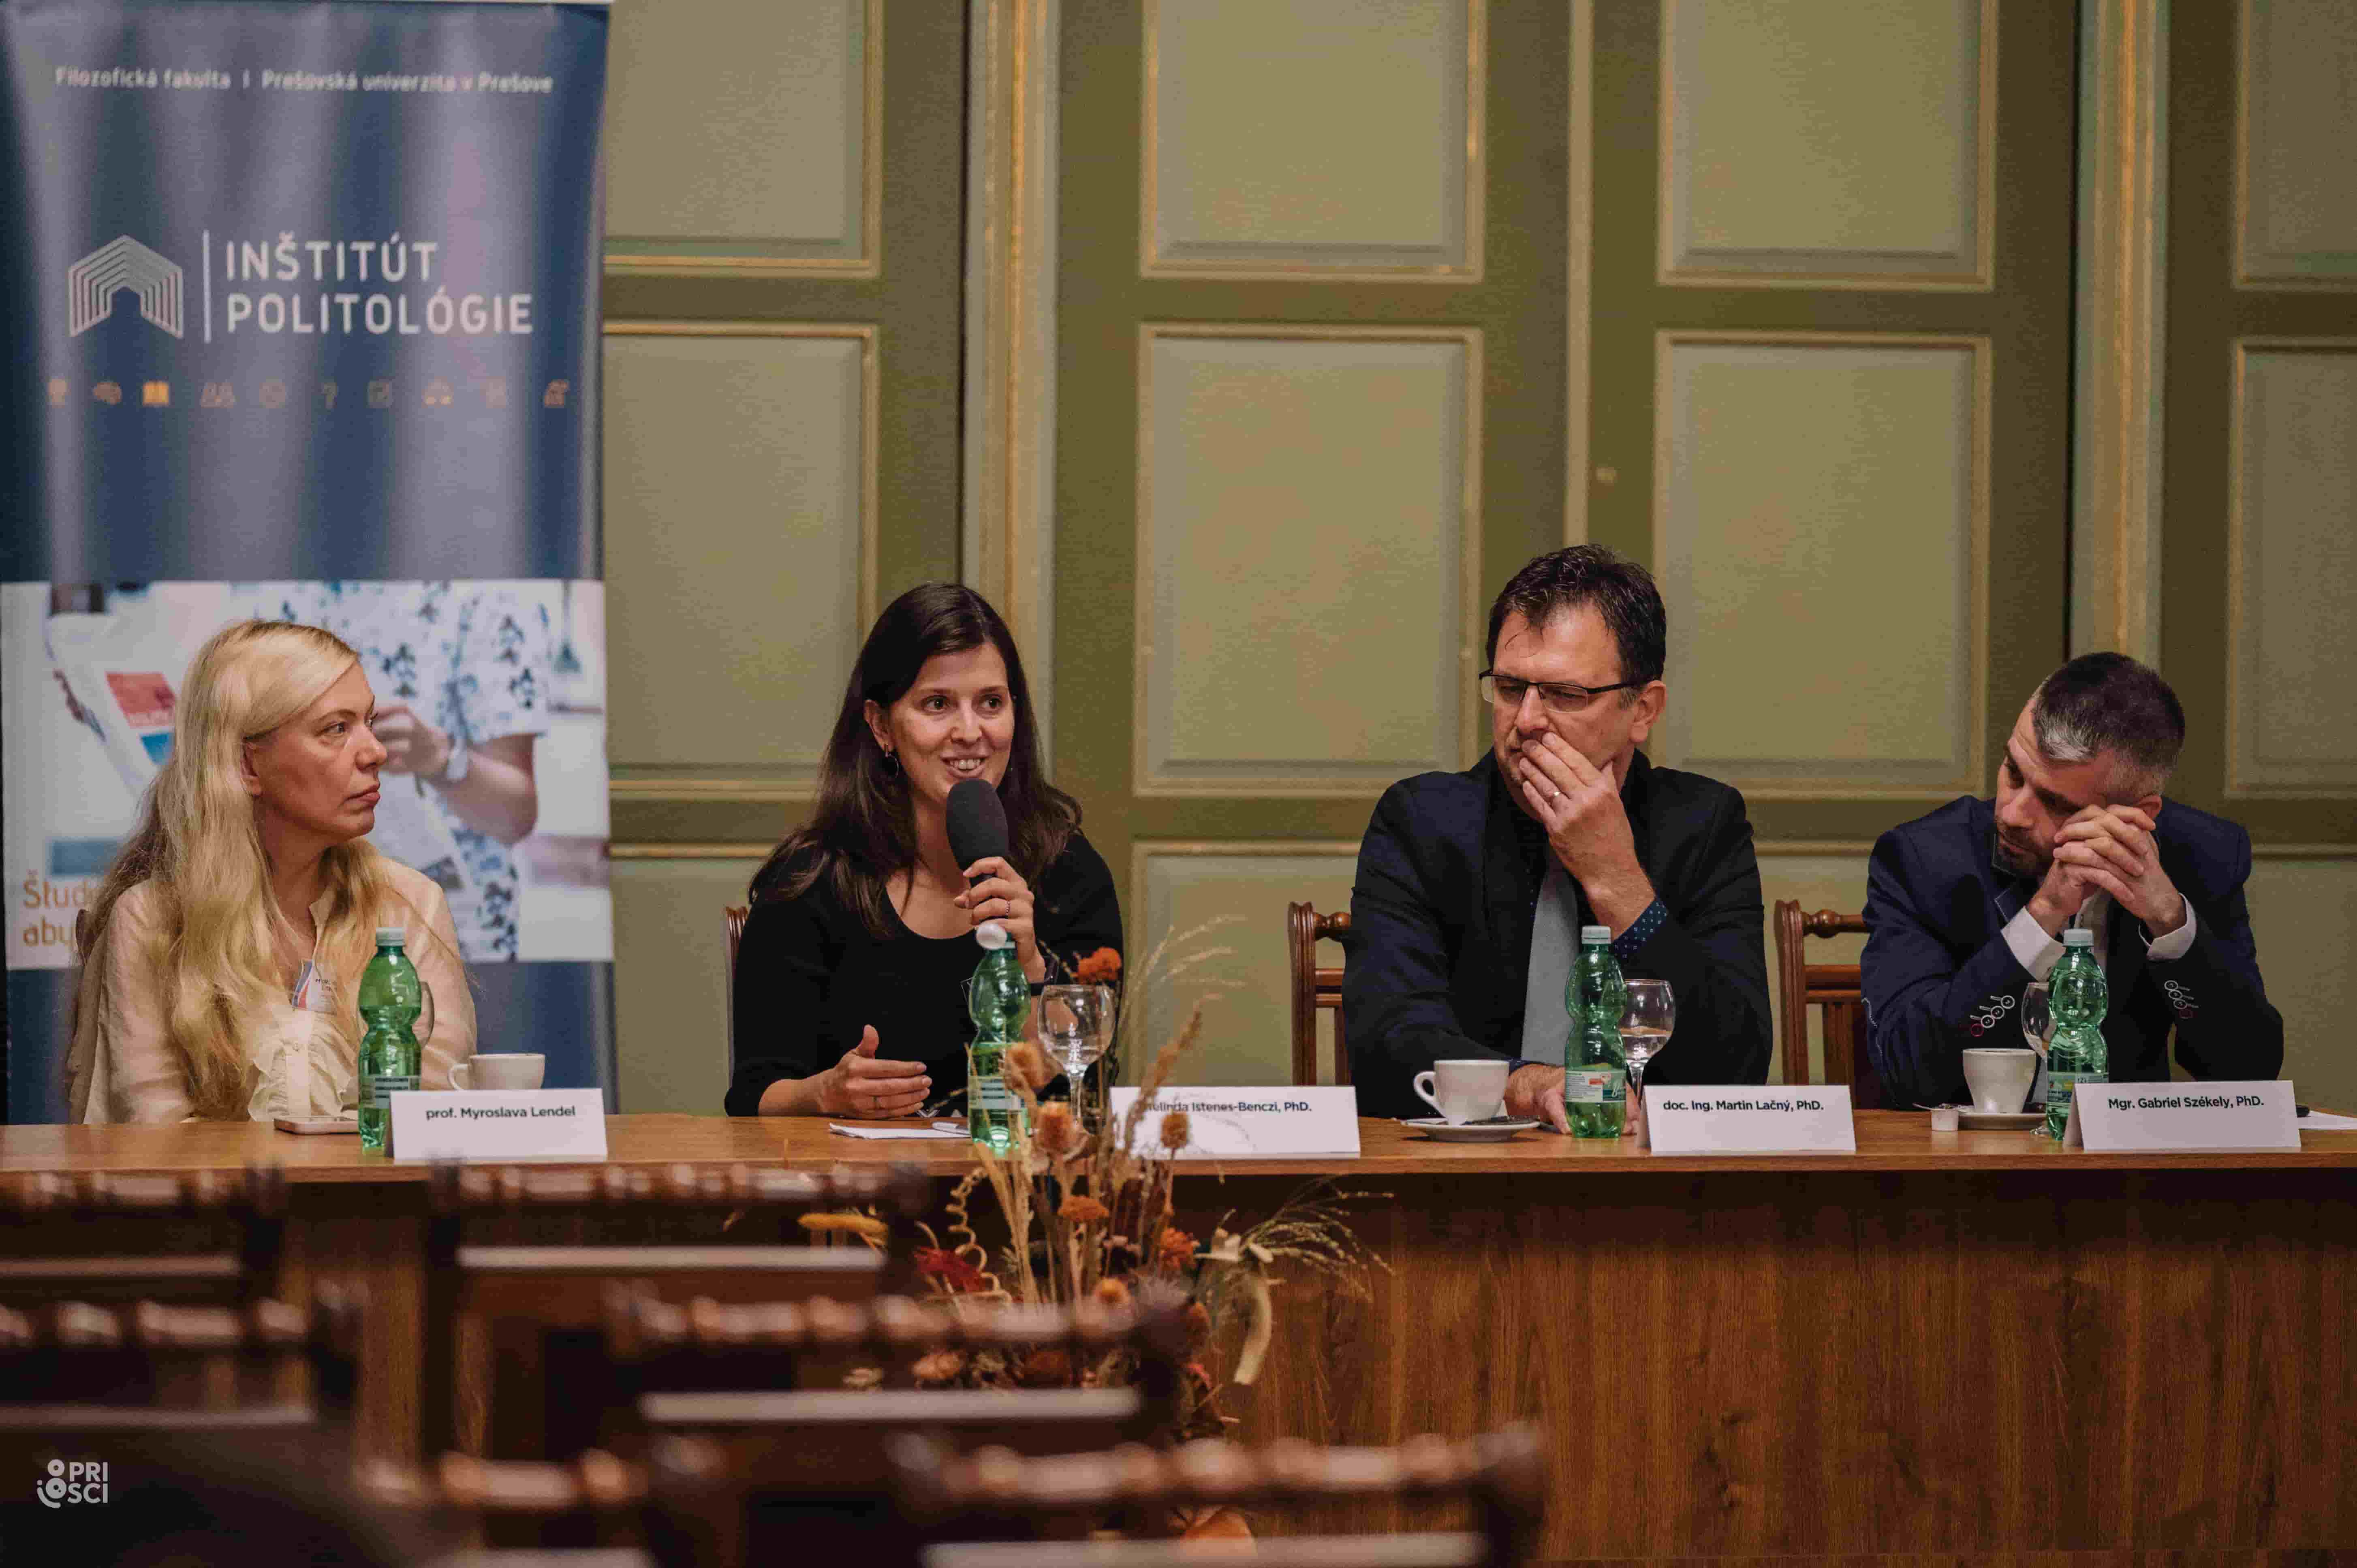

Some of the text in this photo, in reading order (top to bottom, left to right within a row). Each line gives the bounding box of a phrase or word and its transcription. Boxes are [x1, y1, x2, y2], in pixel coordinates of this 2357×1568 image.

[55, 65, 158, 88] Filozofická
[163, 68, 231, 90] fakulta
[262, 68, 357, 90] Prešovská
[363, 72, 455, 92] univerzita
[478, 70, 554, 93] Prešove
[226, 231, 438, 282] INŠTITÚT
[227, 285, 533, 334] POLITOLÓGIE
[22, 869, 89, 908] Štud
[425, 1106, 576, 1121] prof. Myroslava Lendel
[1147, 1101, 1312, 1113] elinda Istenes-Benczi, PhD.
[1663, 1099, 1824, 1111] doc. Ing. Martin Lačný, PhD.
[2108, 1096, 2264, 1110] Mgr. Gabriel Székely, PhD.
